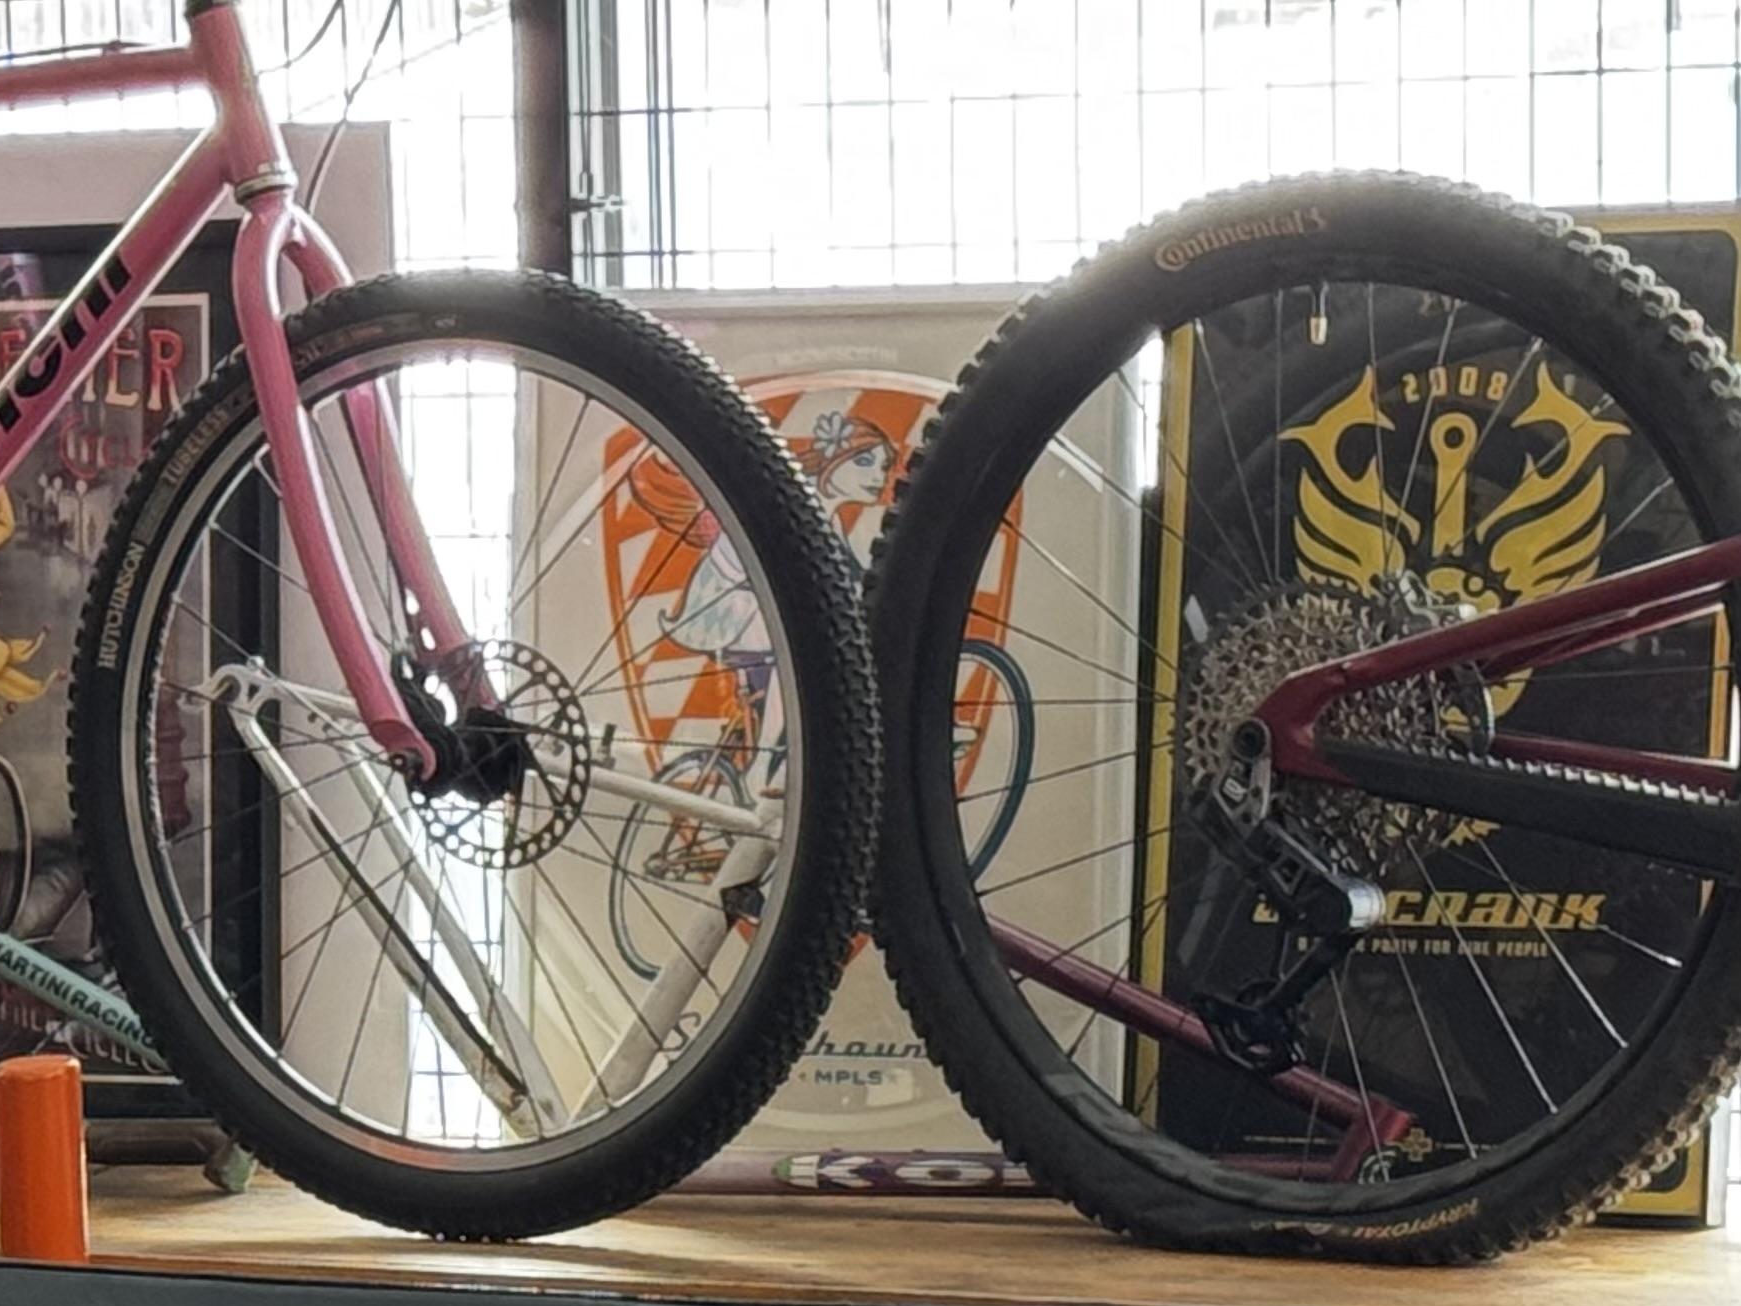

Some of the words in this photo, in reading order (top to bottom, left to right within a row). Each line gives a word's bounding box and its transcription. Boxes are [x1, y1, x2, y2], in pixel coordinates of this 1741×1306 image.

[1155, 208, 1305, 272] Continental
[1402, 366, 1509, 404] 2008
[97, 541, 145, 668] HUTCHINSON
[164, 405, 230, 487] TUBELESS
[1424, 938, 1451, 955] FOR
[814, 1069, 883, 1085] MPLS
